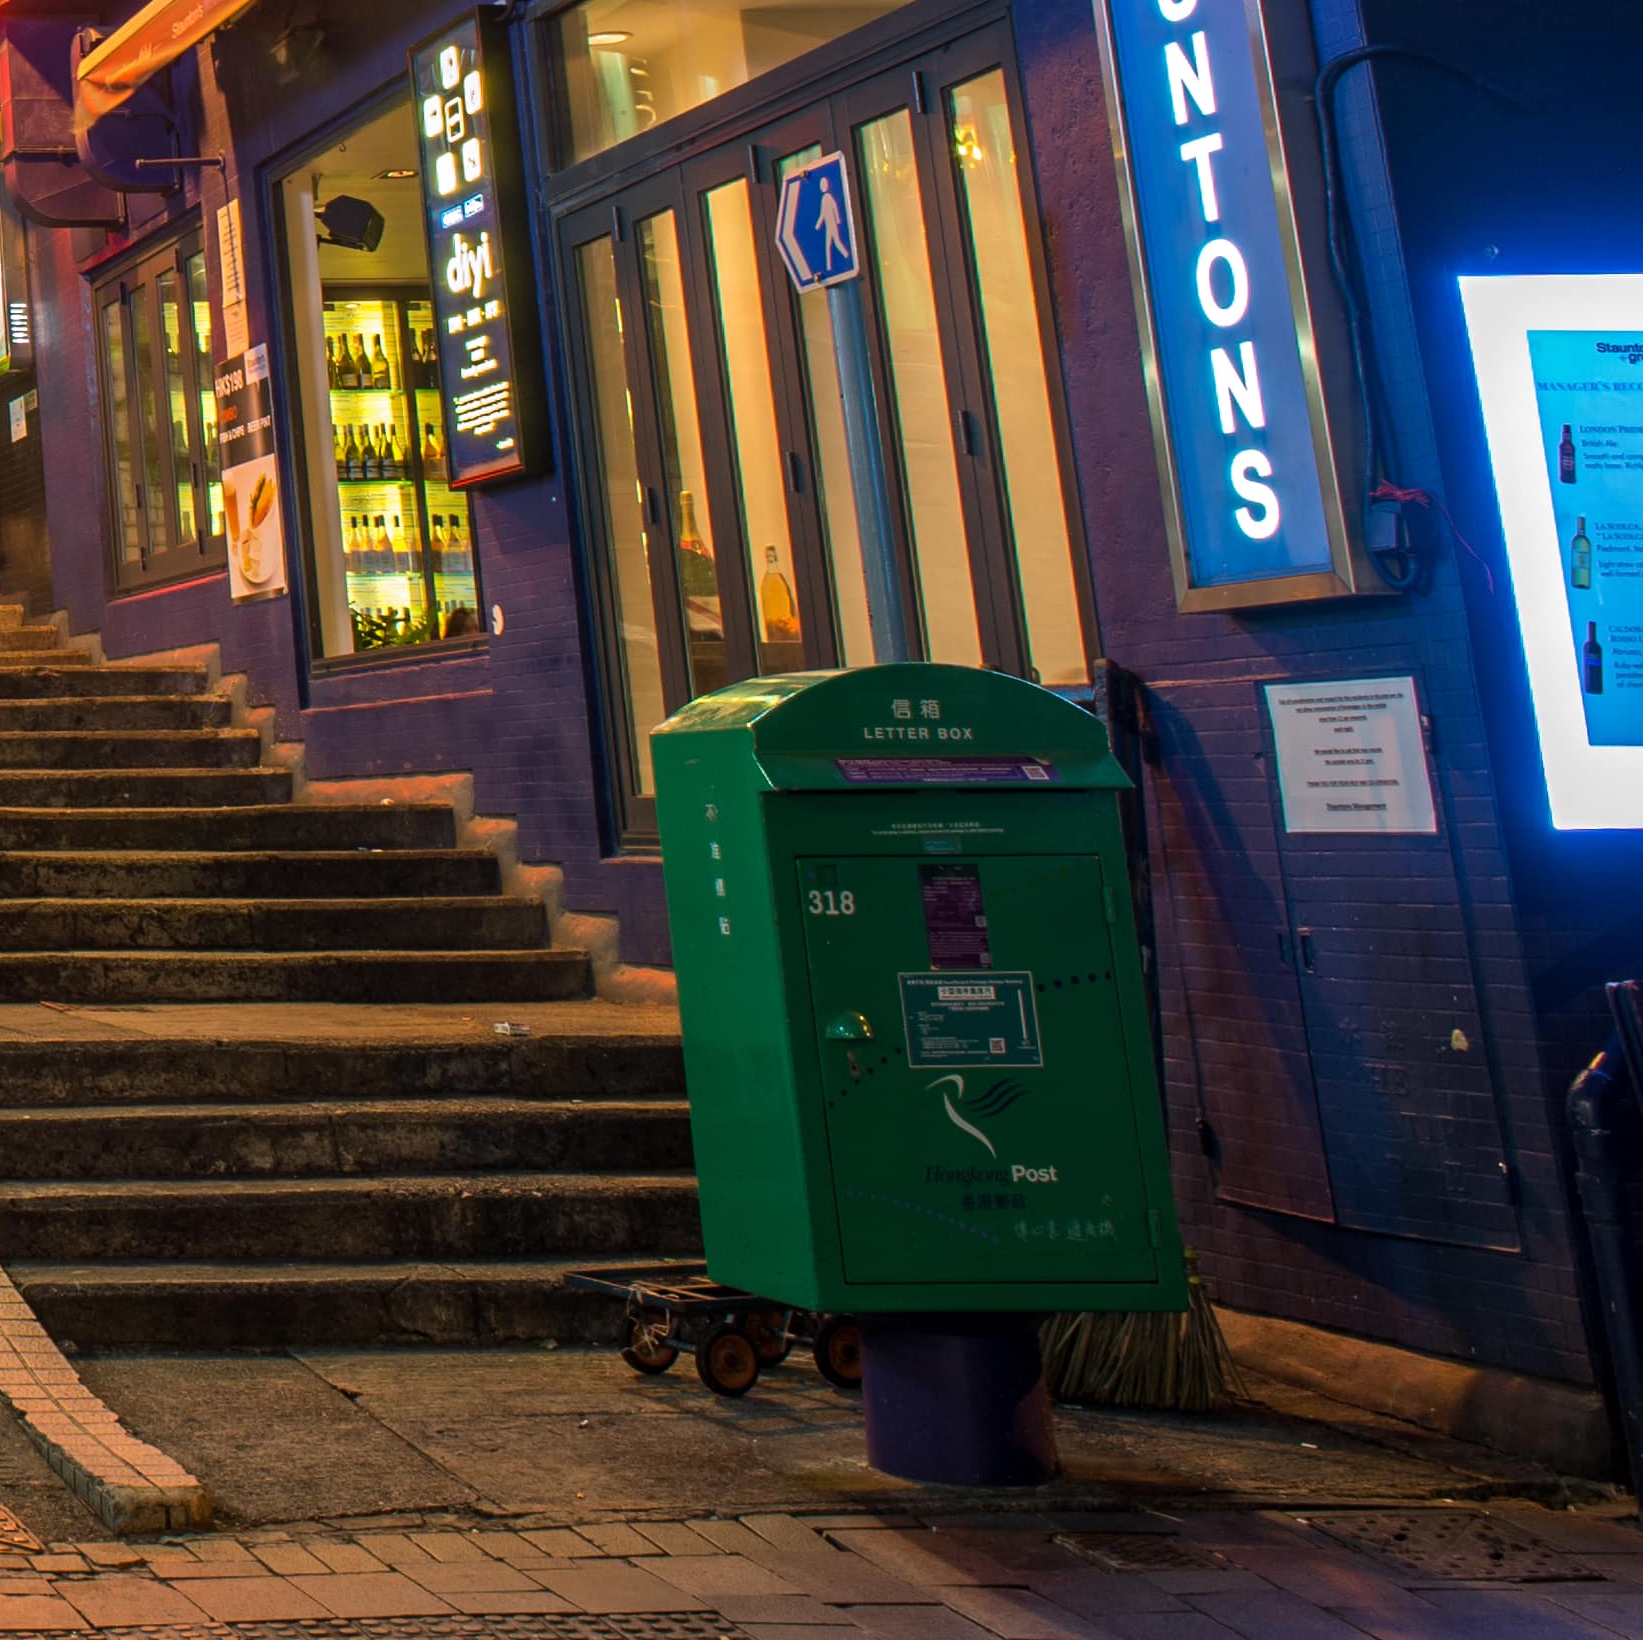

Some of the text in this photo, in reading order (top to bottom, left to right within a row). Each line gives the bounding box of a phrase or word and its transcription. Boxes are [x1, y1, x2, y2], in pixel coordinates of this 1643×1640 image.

[891, 698, 941, 720] 信箱
[863, 726, 974, 740] LETTER BOX
[808, 889, 856, 916] 318
[925, 1164, 1059, 1186] Hongkong Post
